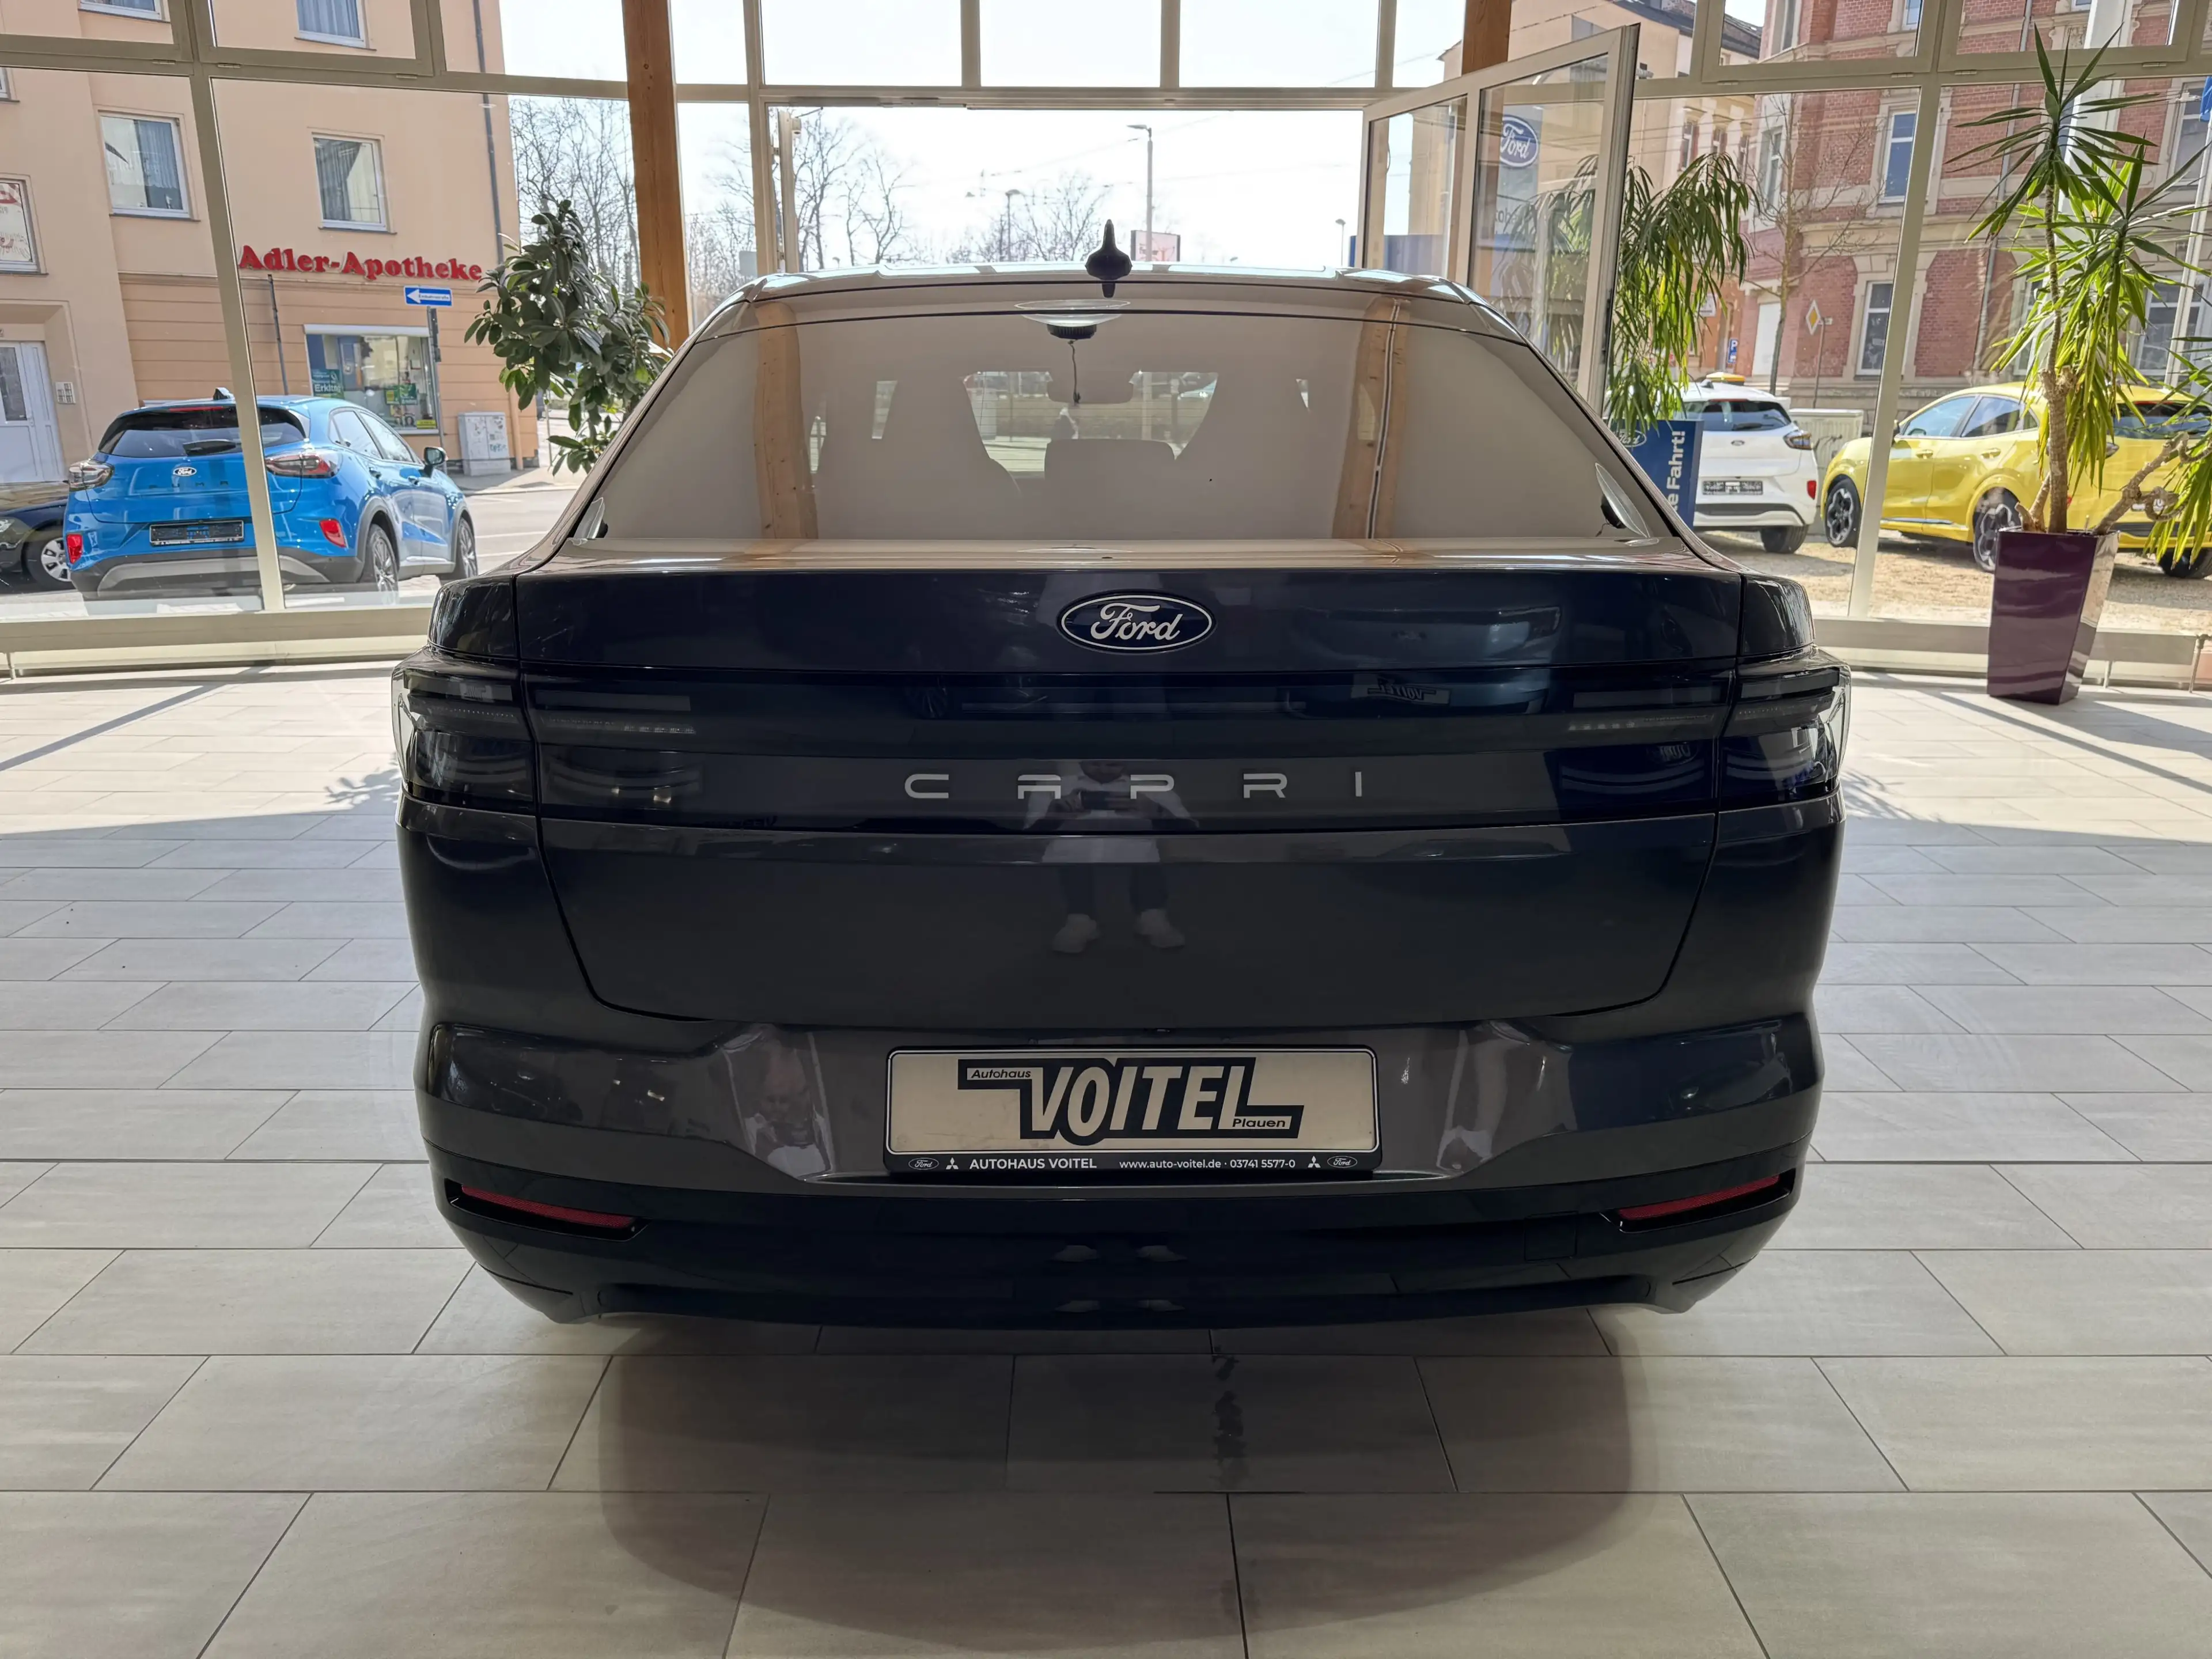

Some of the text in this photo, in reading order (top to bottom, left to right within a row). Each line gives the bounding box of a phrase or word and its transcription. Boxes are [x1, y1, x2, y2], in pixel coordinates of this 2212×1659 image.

[1500, 123, 1531, 159] Ford
[239, 245, 482, 280] Adler-Apotheke
[1666, 431, 1685, 511] e Fahrt!
[1090, 603, 1183, 640] Ford
[904, 771, 1362, 800] CAPRI
[971, 1069, 1031, 1079] Autohaus
[1031, 1066, 1248, 1137] VOITEL
[1232, 1118, 1286, 1127] Plauen
[914, 1158, 1351, 1169] Ford AUTOHAUS VOITEL www.auto-voitel.de 03741 5577-0 Ford
